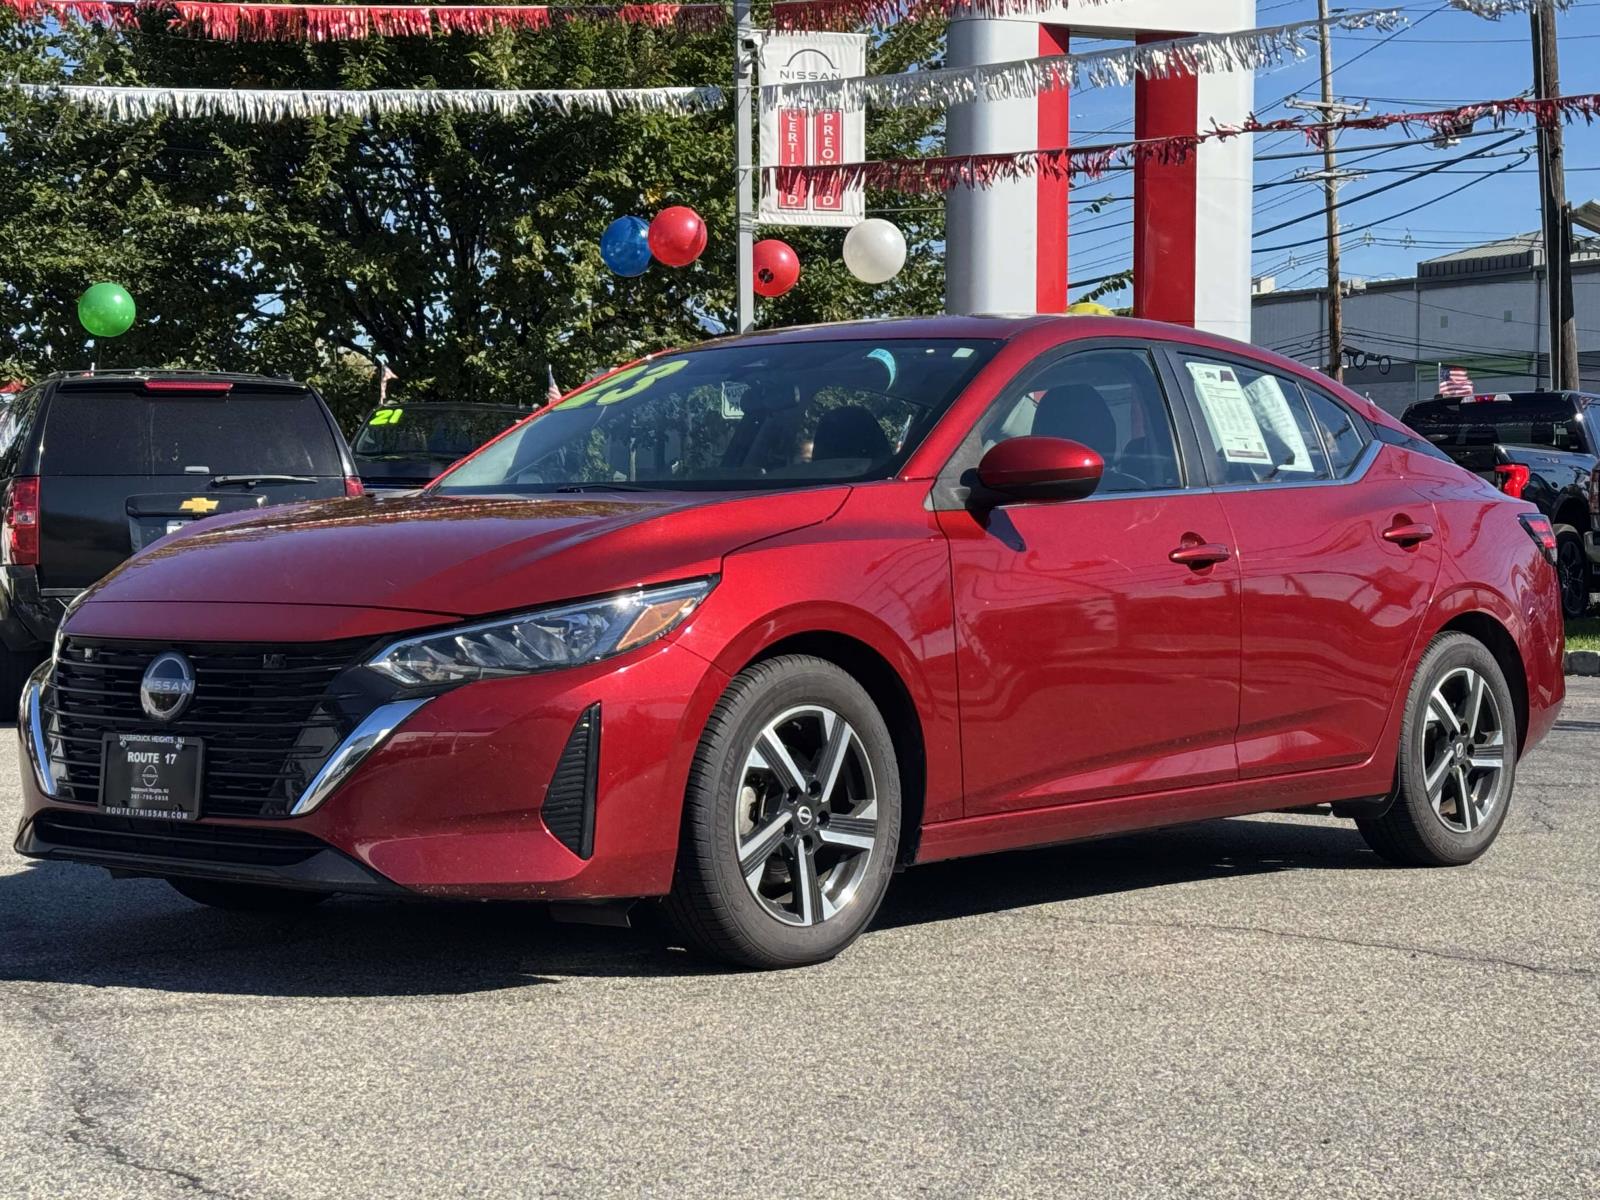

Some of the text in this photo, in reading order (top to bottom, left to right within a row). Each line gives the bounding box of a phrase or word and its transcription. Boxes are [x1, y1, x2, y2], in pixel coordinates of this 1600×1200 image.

[780, 70, 841, 81] NISSAN
[369, 408, 404, 426] 21
[127, 751, 177, 765] ROUTE 17
[105, 806, 188, 820] ROUTE17NISSAN.COM
